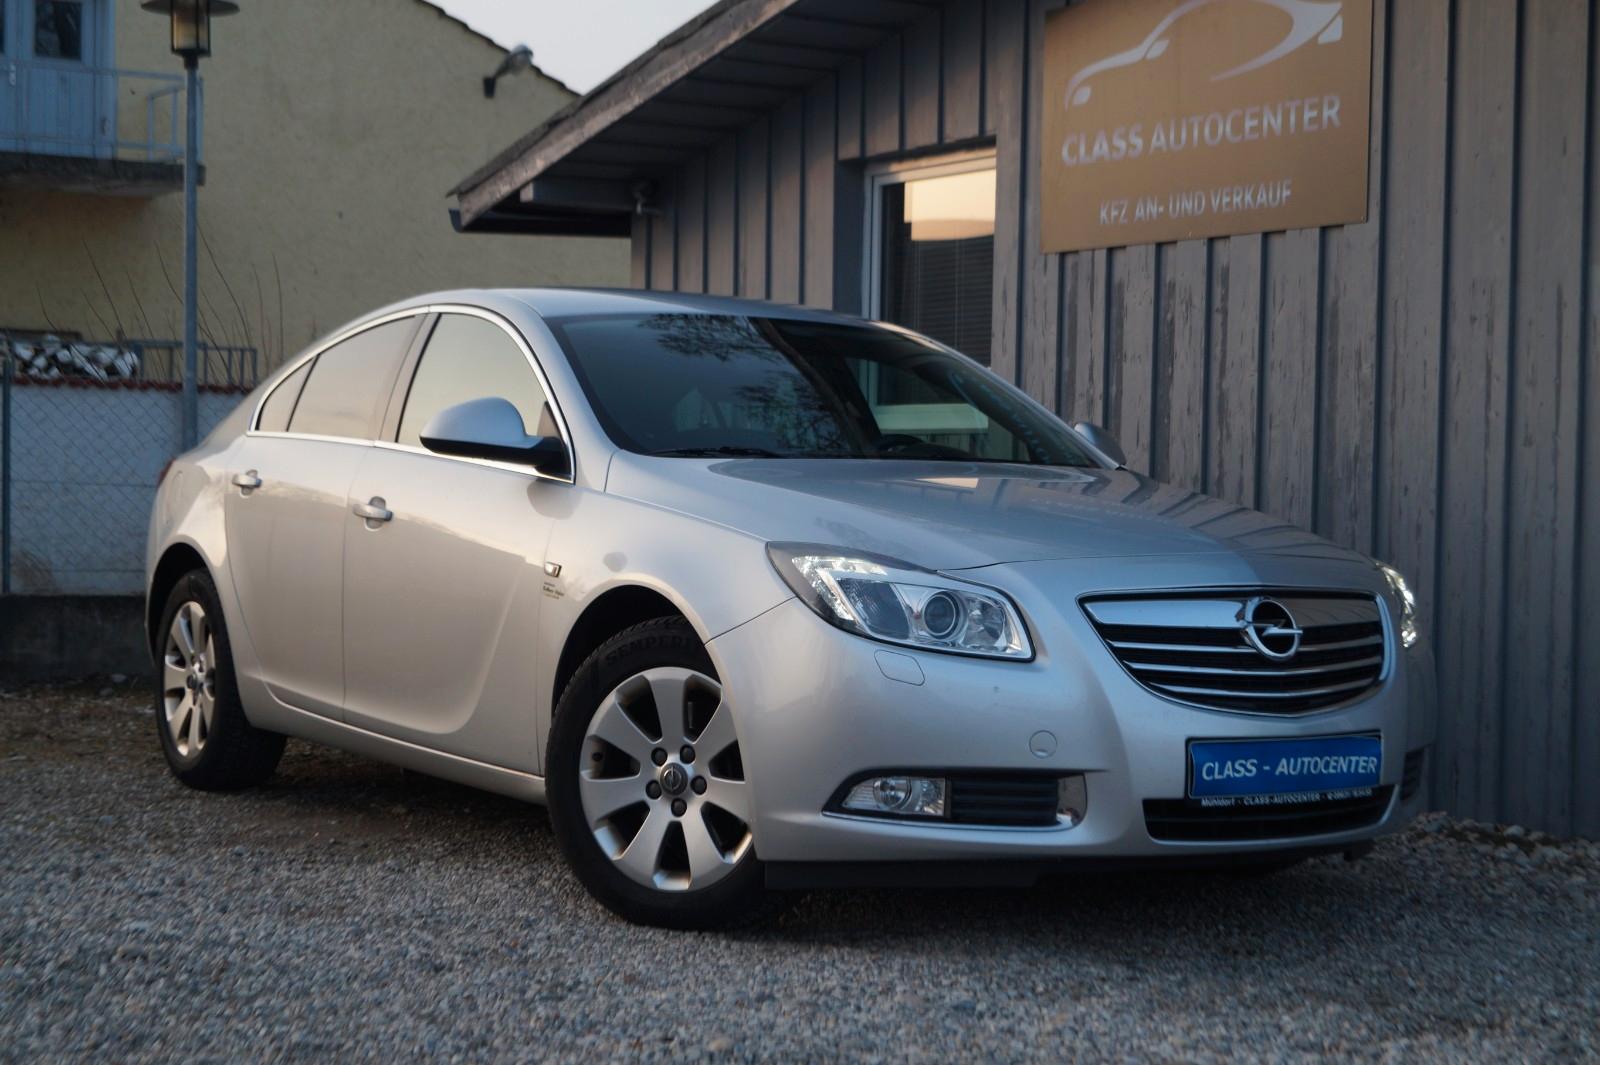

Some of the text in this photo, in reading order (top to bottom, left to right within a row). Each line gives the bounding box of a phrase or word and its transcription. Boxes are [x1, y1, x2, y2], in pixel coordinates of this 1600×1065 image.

[1061, 95, 1341, 167] CLASS AUTOCENTER
[1099, 179, 1292, 225] KFZ AN- UND VERKAUF
[1202, 759, 1257, 781] CLASS
[1275, 756, 1377, 776] AUTOCENTER
